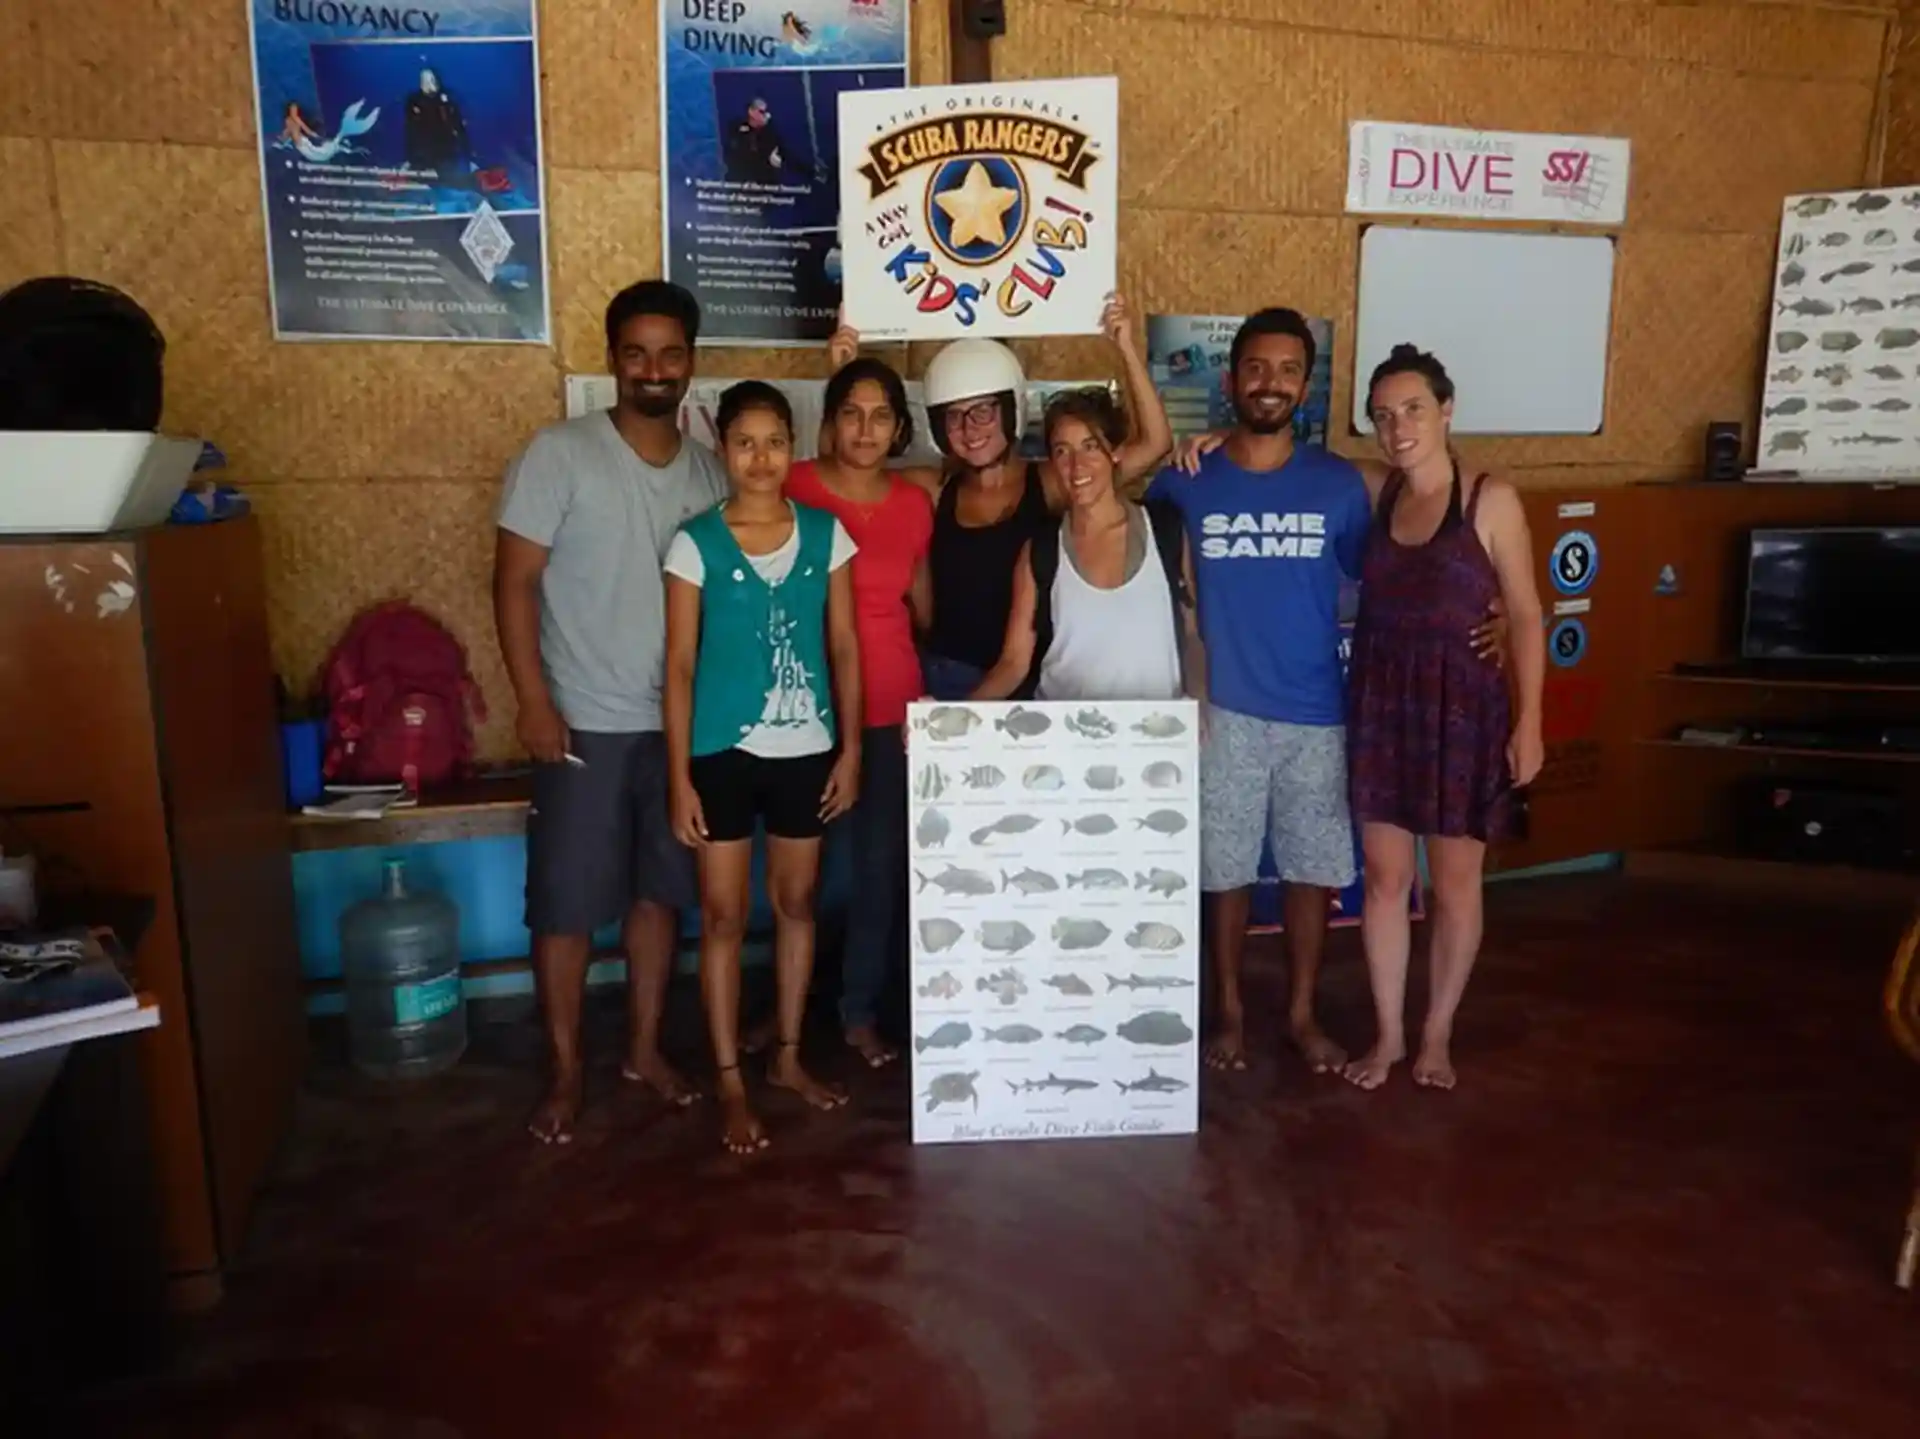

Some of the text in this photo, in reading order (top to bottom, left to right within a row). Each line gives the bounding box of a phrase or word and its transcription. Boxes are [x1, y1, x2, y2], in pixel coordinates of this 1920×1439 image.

[275, 0, 439, 34] BUOYANCY
[682, 0, 746, 23] DEEP
[683, 28, 776, 58] DIVING
[891, 96, 1063, 124] THE ORIGINAL
[881, 119, 1074, 171] SCUBA RANGERS
[1389, 148, 1514, 195] DIVE
[1201, 512, 1326, 535] SAME
[1200, 536, 1325, 559] SAME
